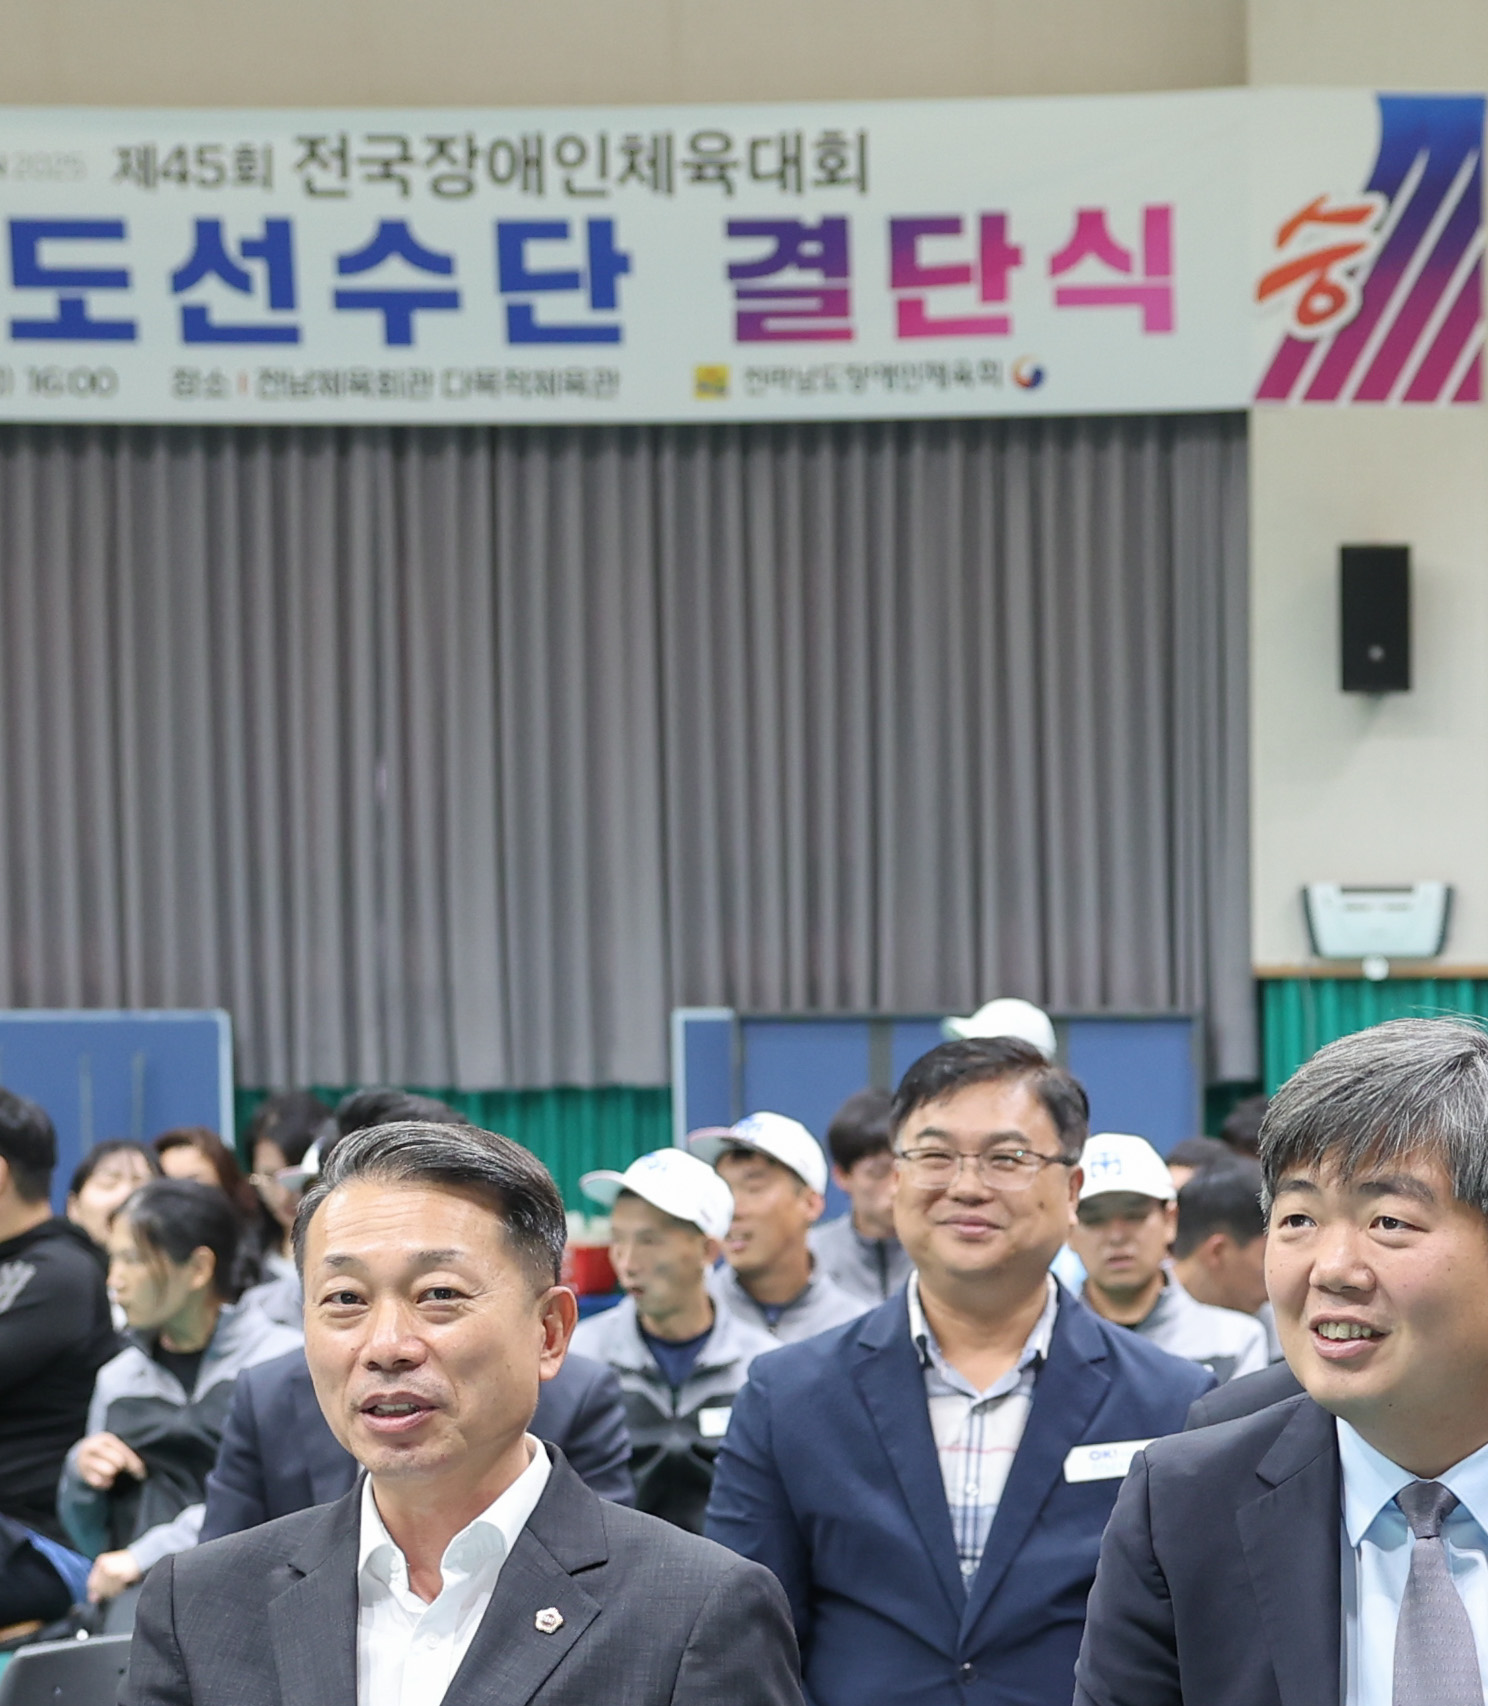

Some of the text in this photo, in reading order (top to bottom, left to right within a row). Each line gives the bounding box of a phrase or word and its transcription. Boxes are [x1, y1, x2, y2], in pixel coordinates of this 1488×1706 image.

[12, 150, 89, 181] 2025
[113, 129, 870, 201] 제45회 전국장애인체육대회
[724, 204, 1175, 344] 결단식
[1256, 194, 1376, 326] 승
